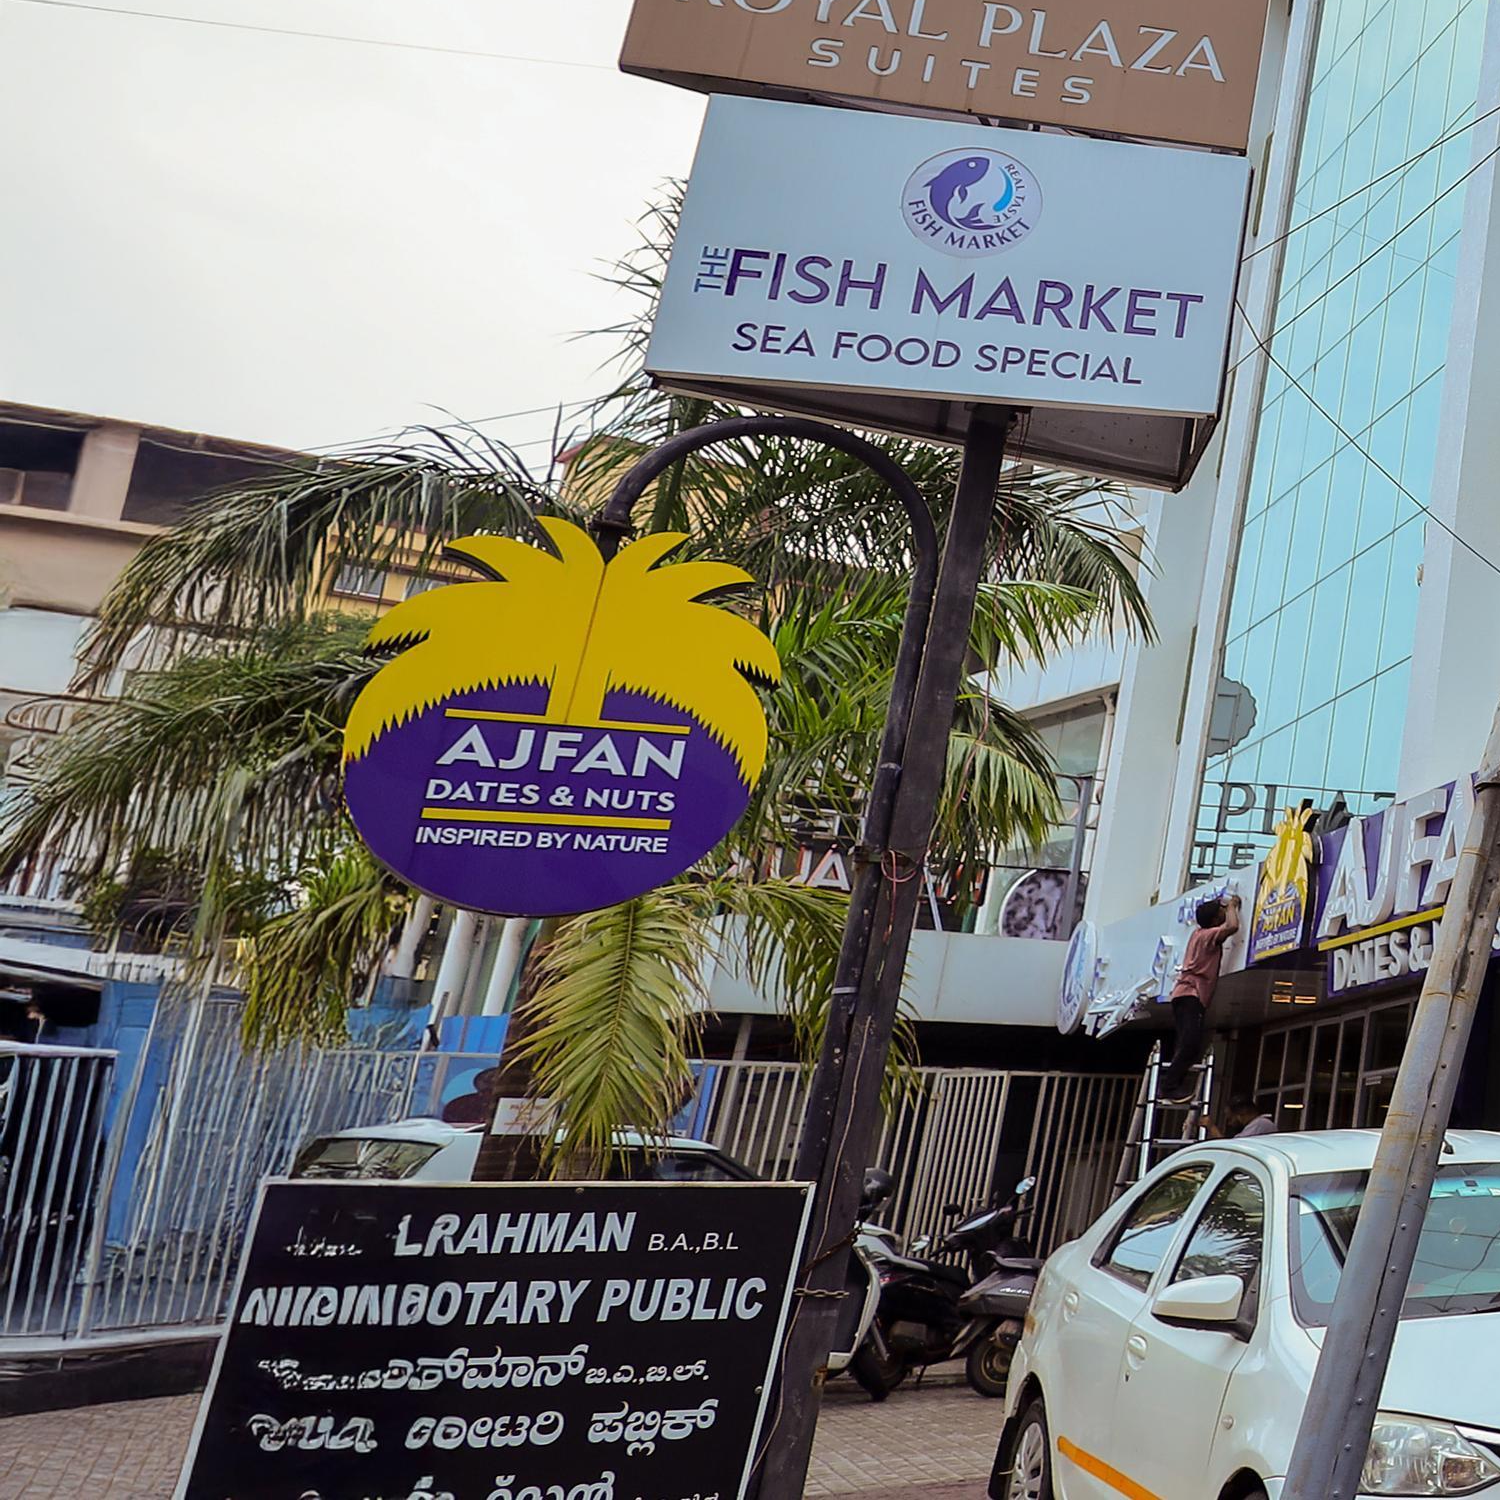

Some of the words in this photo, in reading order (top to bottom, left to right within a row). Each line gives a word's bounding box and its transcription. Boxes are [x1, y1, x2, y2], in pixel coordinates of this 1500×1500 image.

[978, 1, 1226, 83] PLAZA
[807, 38, 1095, 105] SUITES
[1004, 163, 1026, 191] REAL
[908, 200, 943, 237] FISH
[944, 217, 1031, 250] MARKET
[993, 195, 1026, 224] TASTE
[694, 246, 731, 294] THE
[723, 247, 887, 311] FISH
[910, 267, 1205, 340] MARKET
[731, 322, 816, 359] SEA
[832, 331, 961, 368] FOOD
[973, 344, 1142, 386] SPECIAL
[436, 723, 686, 780] AJFAN
[425, 779, 541, 806] DATES
[548, 785, 574, 808] &
[584, 787, 676, 813] NUTS
[415, 826, 532, 848] INSPIRED
[536, 831, 571, 850] BY
[573, 832, 668, 854] NATURE
[1332, 931, 1407, 992] DATES
[596, 1277, 767, 1323] PUBLIC
